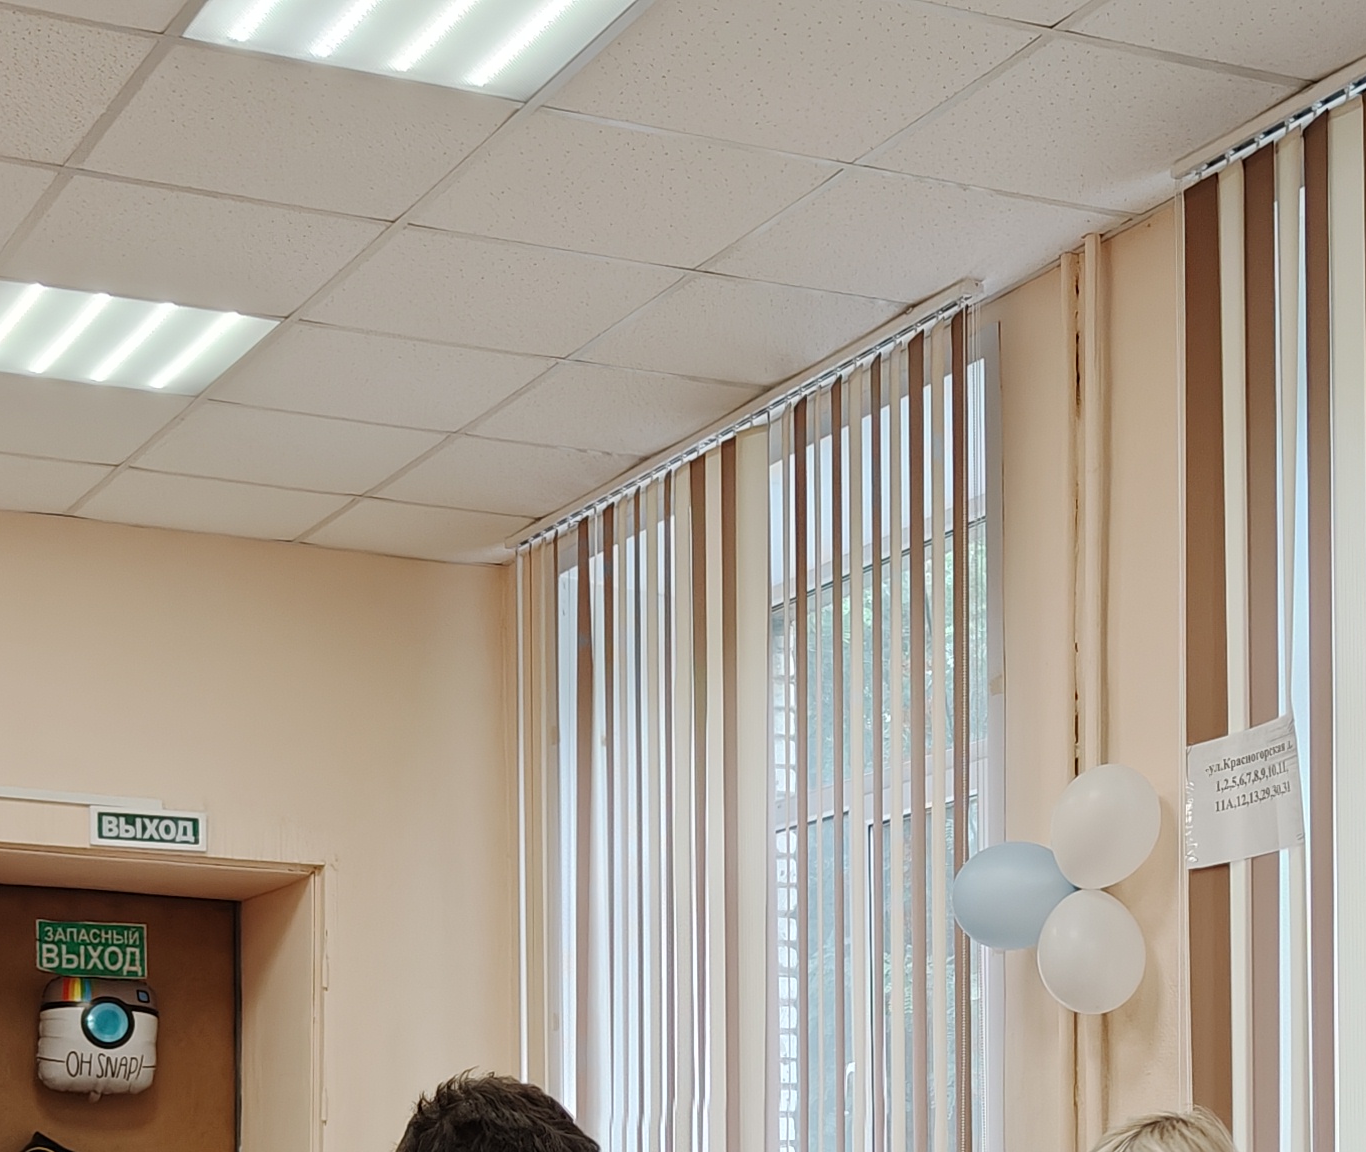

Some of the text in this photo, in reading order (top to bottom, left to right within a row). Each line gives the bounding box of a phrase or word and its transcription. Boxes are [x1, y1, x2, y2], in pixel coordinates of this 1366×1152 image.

[102, 815, 195, 843] ВЫХОД
[44, 926, 139, 946] ЗАПАСНЫЙ
[42, 944, 142, 976] ВЫХОД
[66, 1051, 92, 1078] OH
